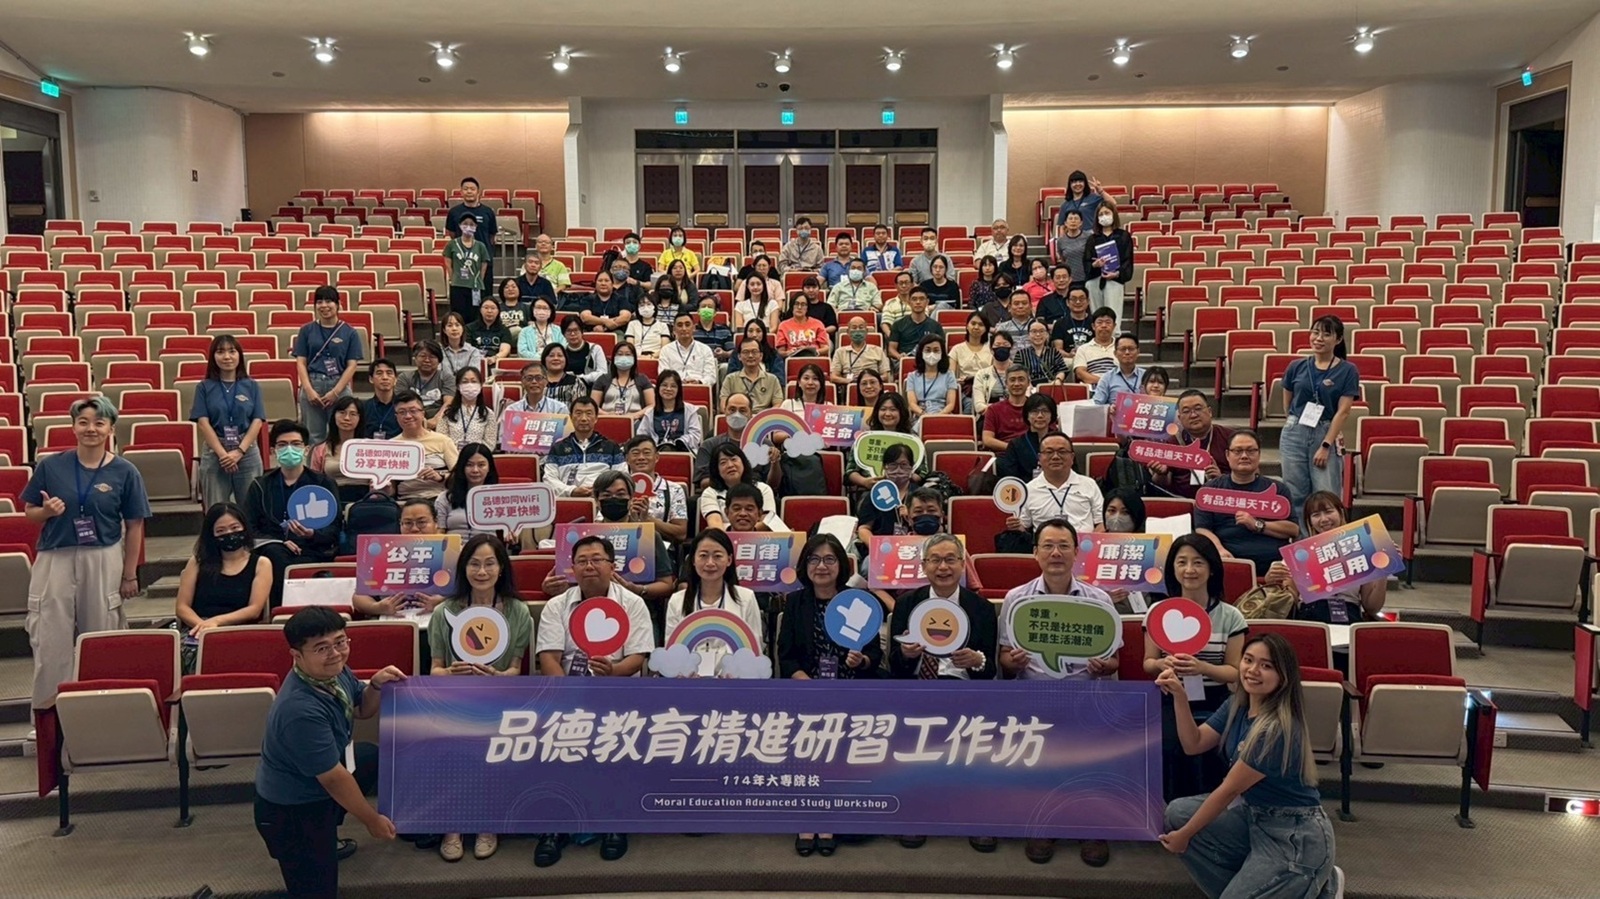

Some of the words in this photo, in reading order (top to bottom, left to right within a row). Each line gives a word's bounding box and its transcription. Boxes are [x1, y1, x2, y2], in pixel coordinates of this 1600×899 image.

[1131, 417, 1166, 432] 感恩
[821, 427, 853, 440] 生命
[355, 448, 410, 458] 品德如同WiFi
[1135, 445, 1194, 464] 有品走遍天下
[355, 459, 410, 470] 分享更快樂
[482, 494, 540, 506] 品德如同WiFi
[1202, 493, 1269, 511] 有品走遍天下
[483, 504, 541, 518] 分享更快樂
[387, 546, 434, 564] 公平
[736, 543, 781, 561] 自律
[1098, 543, 1145, 560] 廉潔
[383, 567, 431, 585] 正義
[736, 564, 778, 582] 負責
[1095, 563, 1143, 581] 自持
[1323, 554, 1370, 584] 信用
[1028, 620, 1105, 636] 不只是社交禮儀
[1028, 632, 1093, 647] 更是生活潮流
[485, 707, 1055, 767] 品德教育精進研習工作坊
[722, 773, 820, 787] 114年大專院校
[654, 797, 686, 807] Moral
[689, 797, 743, 807] Education
[745, 797, 798, 808] Advanced
[800, 798, 831, 809] Study
[834, 798, 888, 809] Workshop
